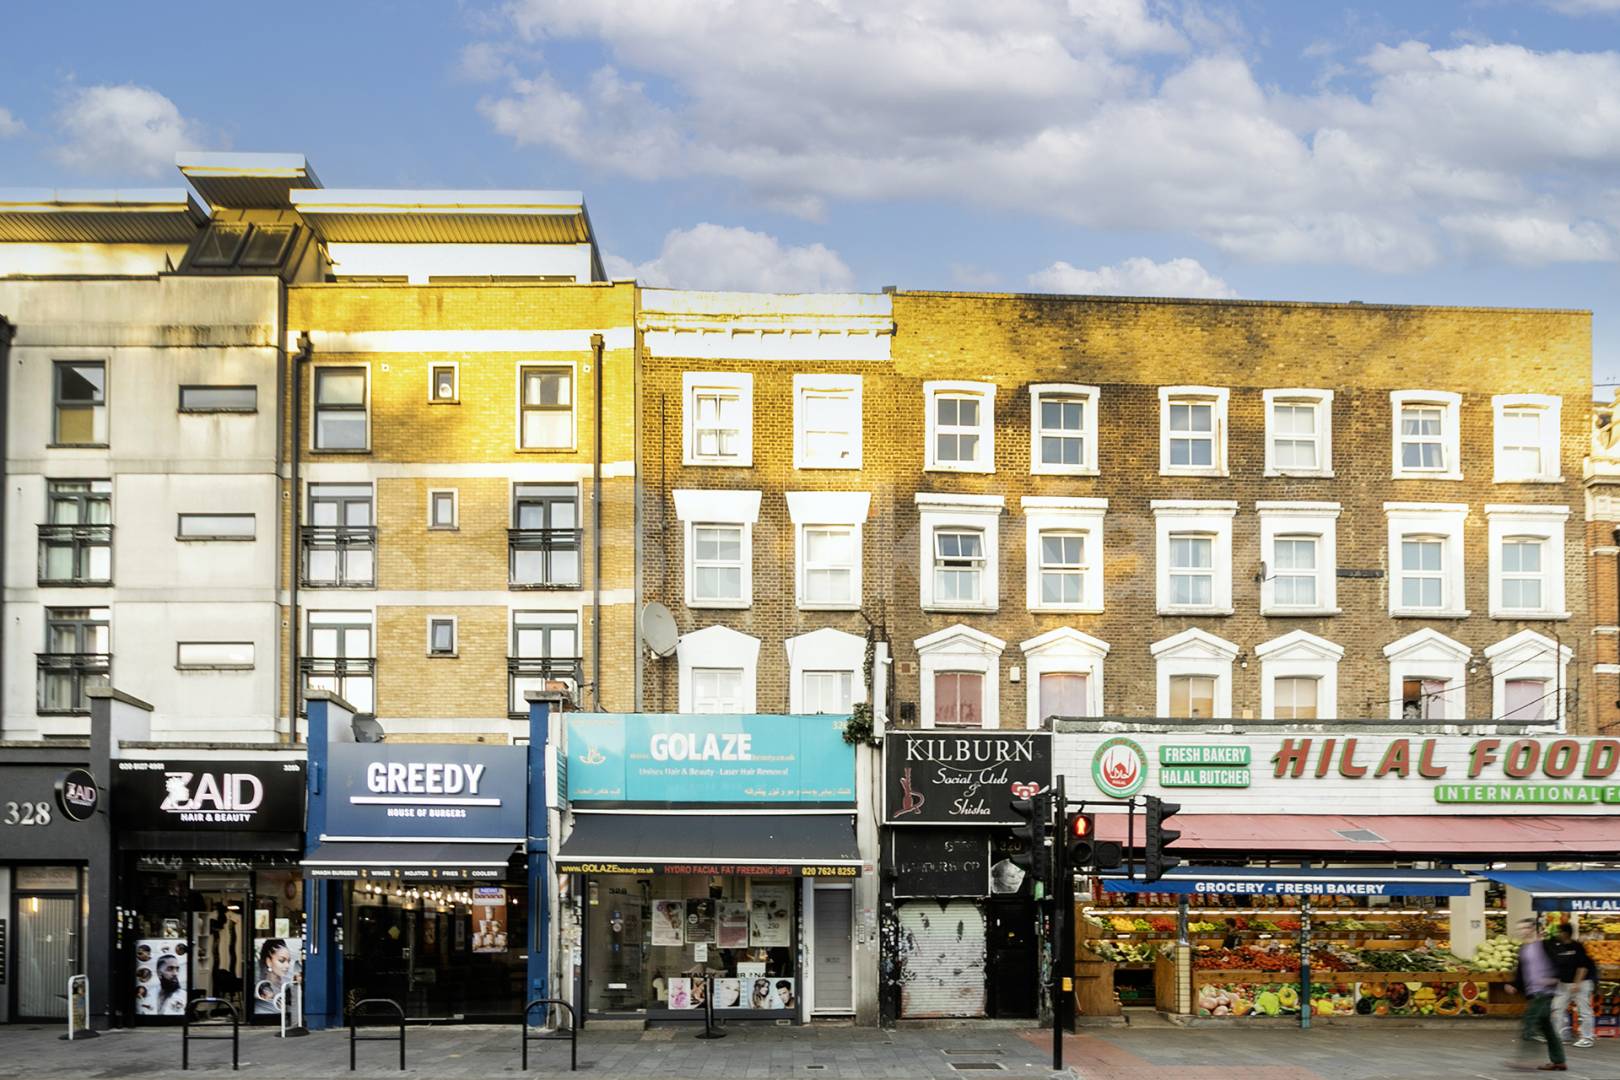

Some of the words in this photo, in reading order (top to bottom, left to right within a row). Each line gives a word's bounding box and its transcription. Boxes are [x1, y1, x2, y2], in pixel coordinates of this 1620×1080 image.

[650, 732, 752, 761] GOLAZE
[905, 739, 1034, 762] KILBURN
[1165, 747, 1200, 763] FRESH
[1202, 747, 1247, 763] BAKERY
[1271, 738, 1447, 779] HILAL
[1468, 739, 1620, 779] FOOD
[367, 761, 486, 794] GREEDY
[720, 767, 738, 777] Laser
[932, 768, 972, 785] Social
[979, 768, 1009, 785] Club
[1162, 769, 1199, 785] HALAL
[1200, 769, 1249, 785] BUTCHER
[1438, 785, 1600, 802] INTERNATIONAL
[4, 801, 51, 826] 328
[387, 808, 414, 817] HOUSE
[417, 809, 427, 817] OF
[429, 809, 466, 818] BURGERS
[949, 799, 991, 815] Shisha
[181, 813, 204, 822] HAIR
[205, 813, 213, 822] &
[215, 813, 250, 822] BEAUTY
[371, 869, 391, 877] WINGS
[472, 869, 498, 877] COOLERS
[664, 865, 691, 874] HYDRO
[693, 865, 719, 874] FACIAL
[721, 866, 734, 875] FAT
[736, 866, 774, 876] FREEZING
[775, 866, 792, 876] HIFU
[802, 867, 816, 876] 020
[817, 867, 836, 876] 7624
[837, 867, 856, 876] 8255
[1195, 882, 1264, 894] GROCERY
[1276, 883, 1324, 894] FRESH
[1327, 883, 1385, 895] BAKERY
[1571, 899, 1620, 911] HALAL
